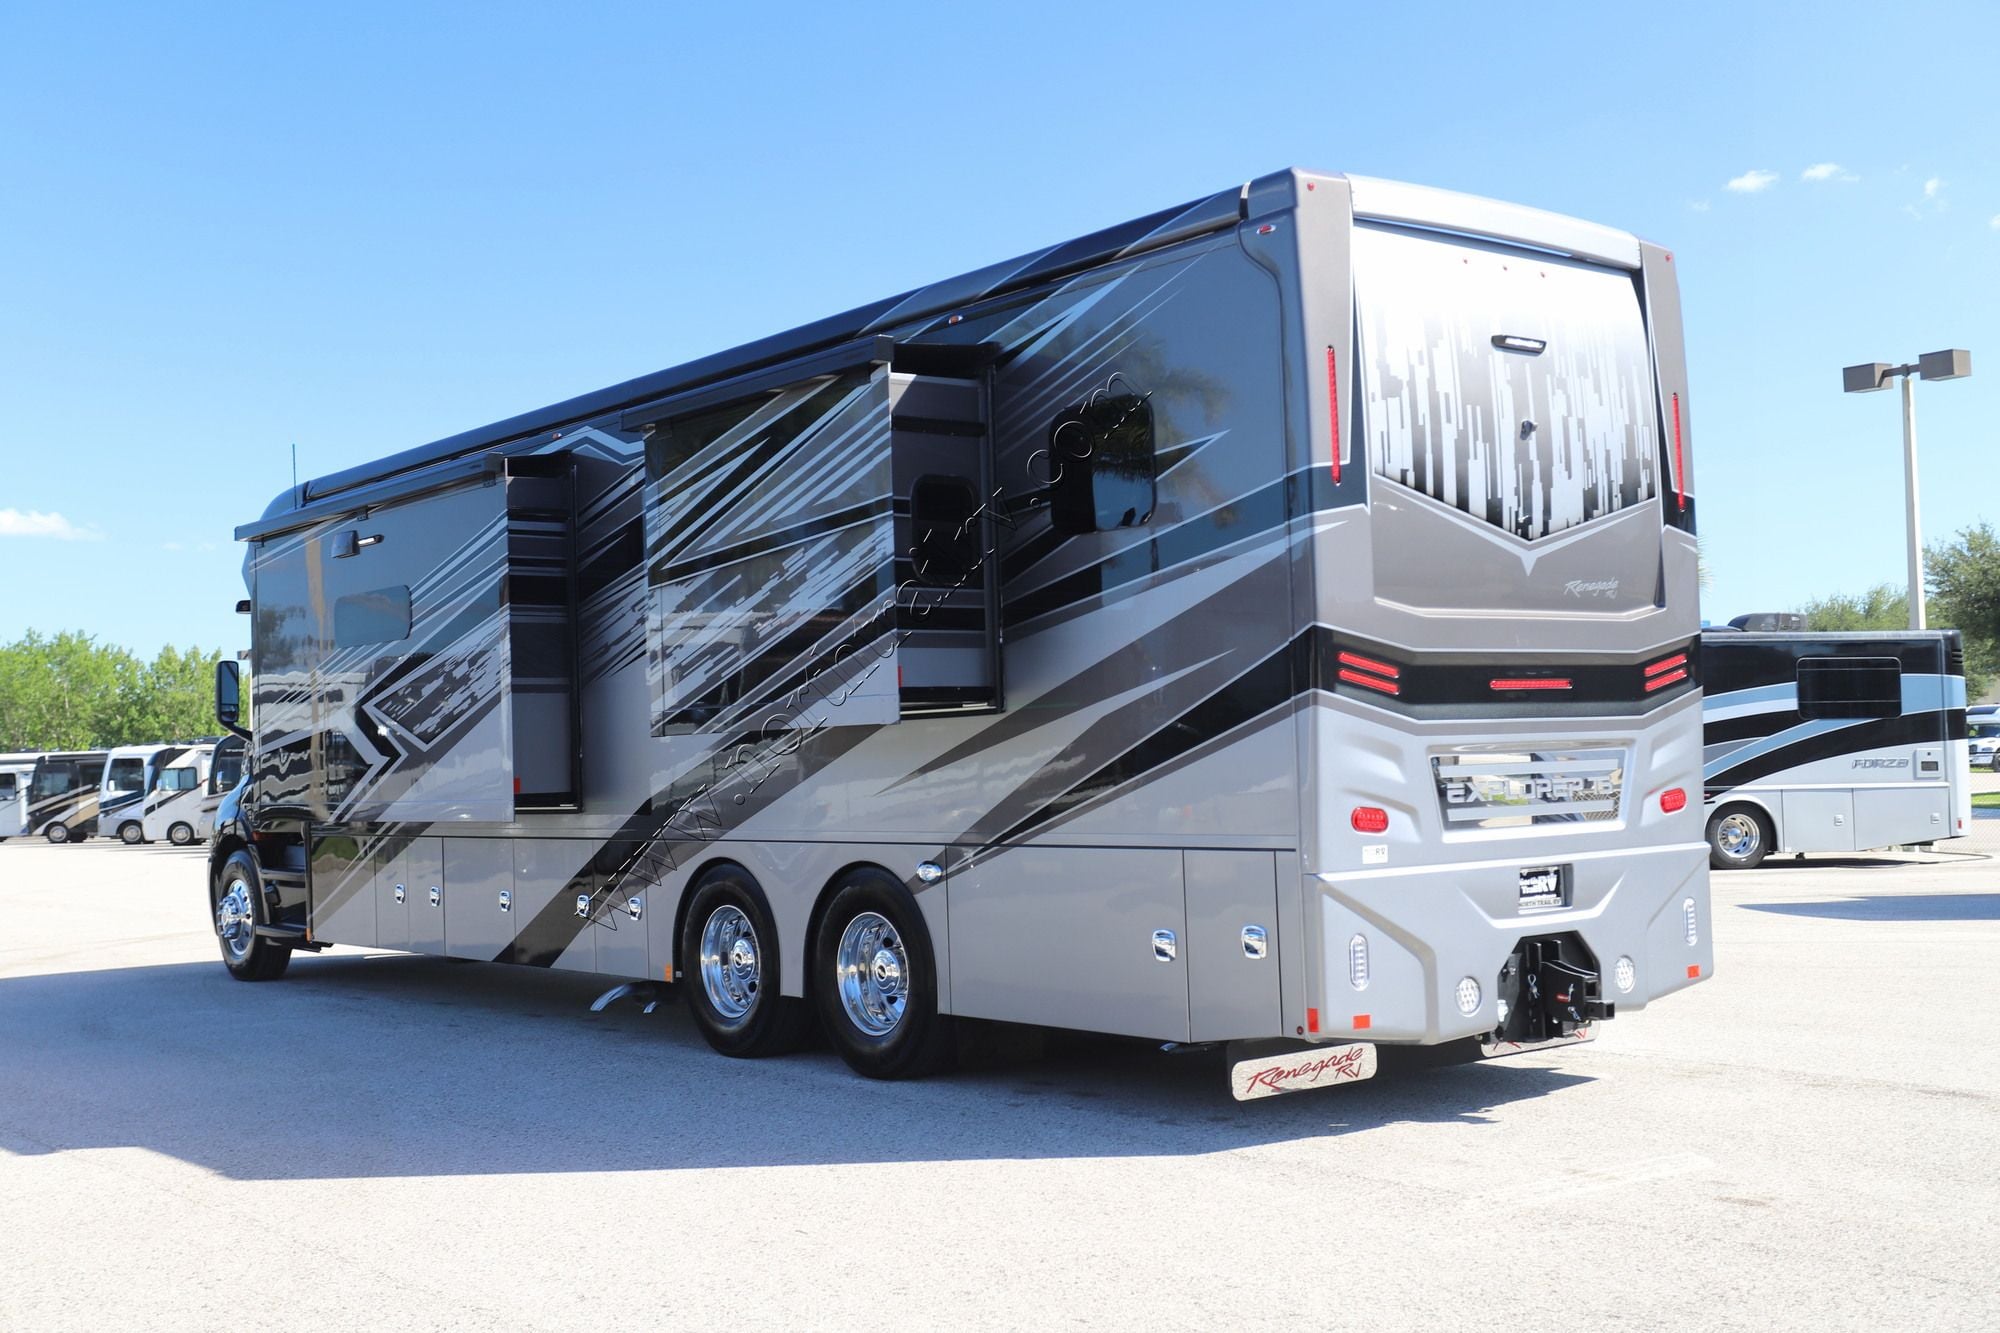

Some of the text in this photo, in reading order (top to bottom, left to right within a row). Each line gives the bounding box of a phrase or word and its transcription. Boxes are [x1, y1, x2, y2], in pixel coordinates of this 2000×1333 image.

[1563, 576, 1619, 598] Renegade
[1851, 759, 1910, 769] FORZA
[1446, 776, 1584, 803] EXPLORER
[1246, 1046, 1364, 1093] Renegade
[1334, 1062, 1362, 1080] RV
